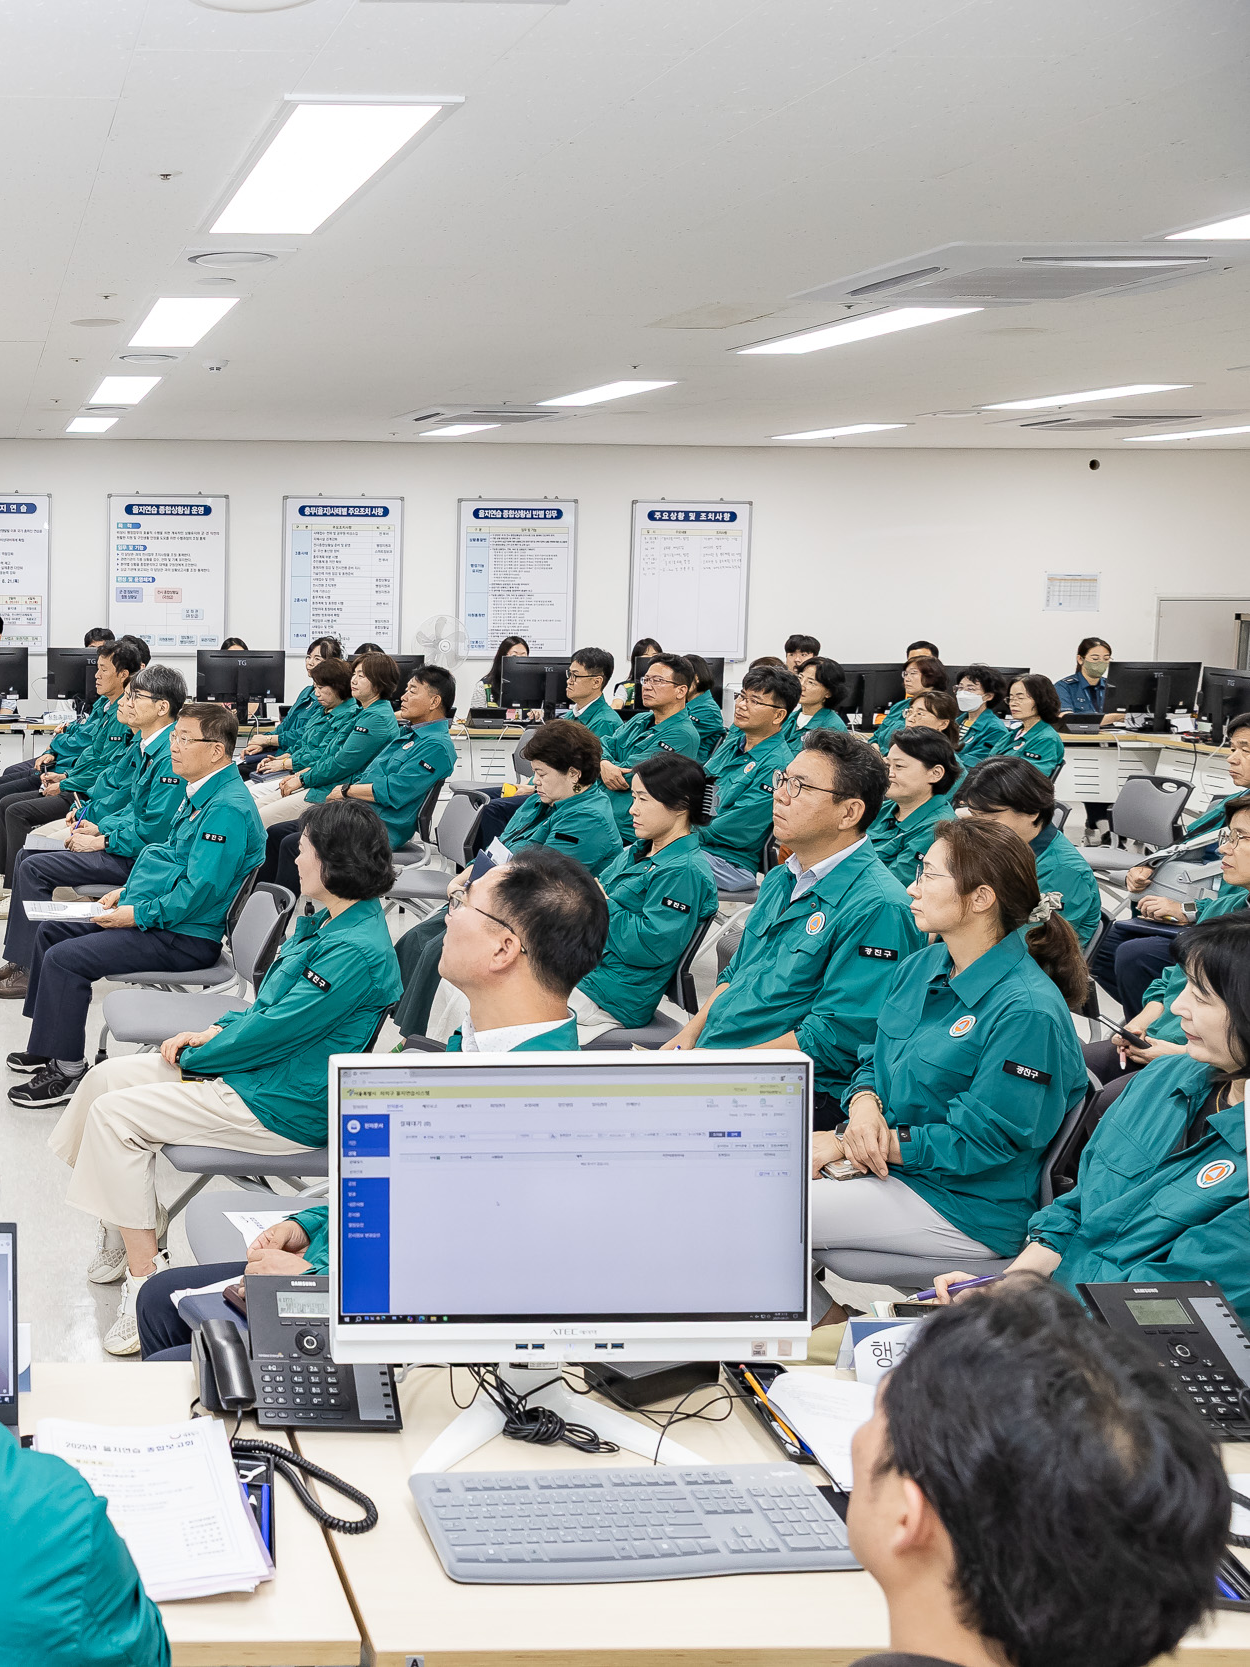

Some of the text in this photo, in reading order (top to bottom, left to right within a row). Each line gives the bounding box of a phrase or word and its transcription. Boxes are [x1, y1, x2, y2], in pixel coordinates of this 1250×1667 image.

[132, 506, 157, 514] 을지연습
[159, 506, 190, 514] 종합상황실
[304, 507, 347, 515] 충무(을지)사태별
[372, 508, 383, 516] 사항
[478, 510, 557, 518] 을지연습 종합상황실 반별 임무
[654, 512, 730, 521] 주요상황 및 조치사항
[205, 833, 224, 842] 광진구
[666, 899, 687, 911] 광진구
[864, 947, 892, 957] 광진구
[306, 970, 327, 989] 광진구
[1015, 1065, 1039, 1078] 광진구
